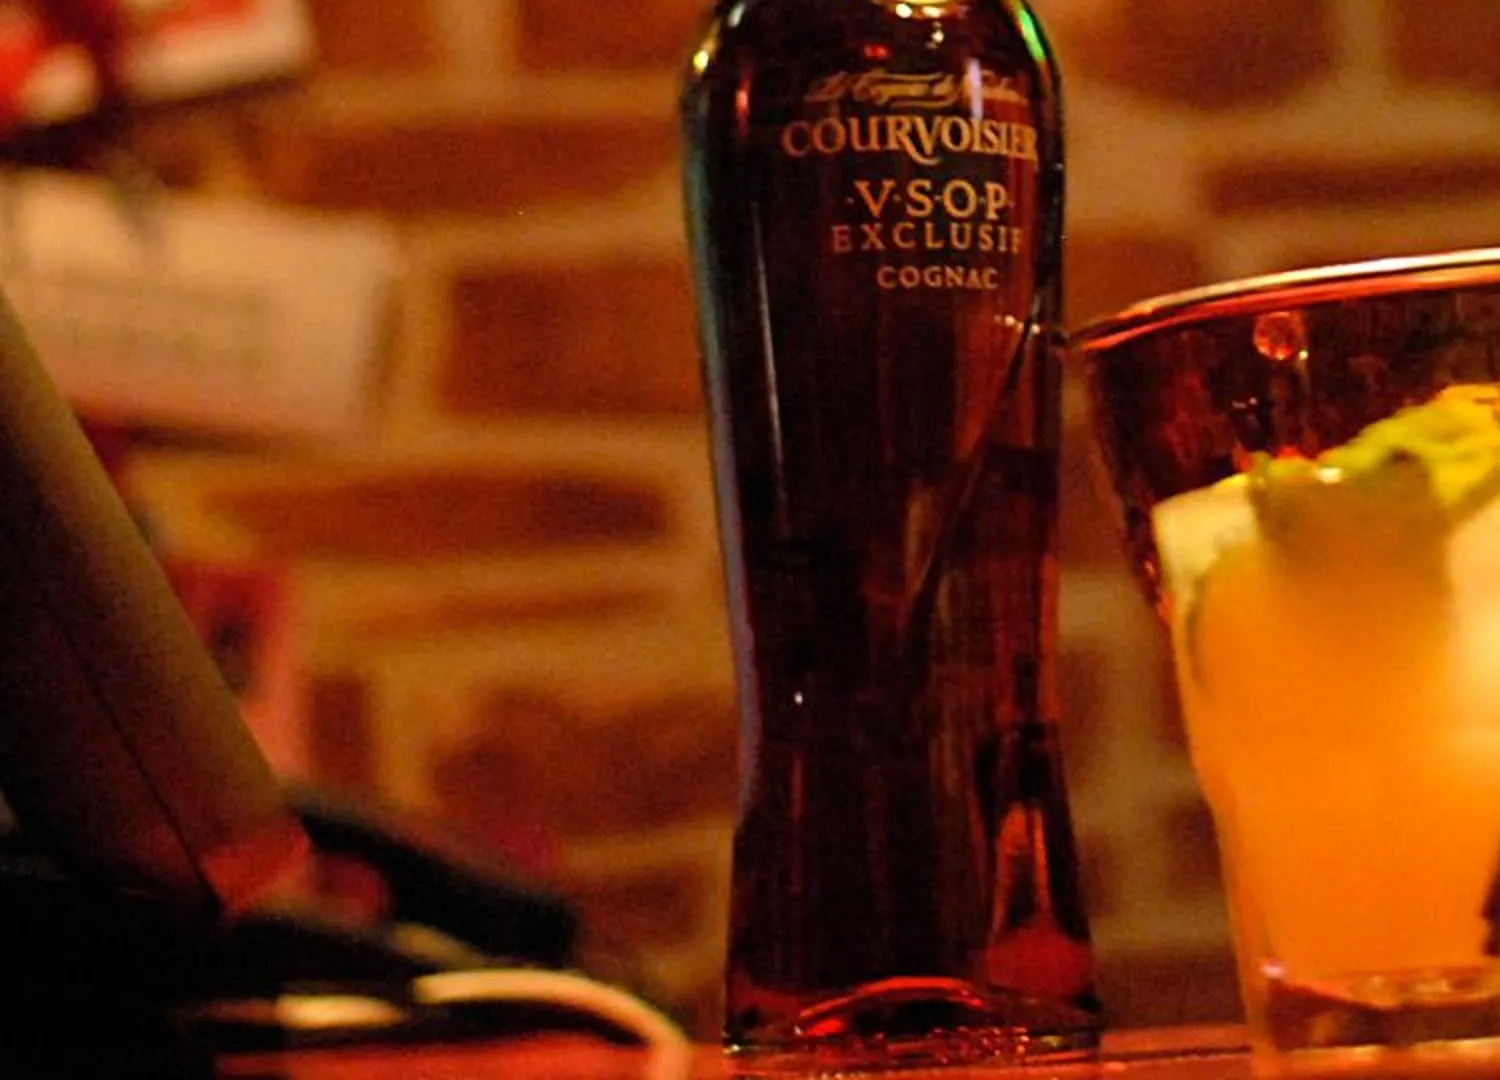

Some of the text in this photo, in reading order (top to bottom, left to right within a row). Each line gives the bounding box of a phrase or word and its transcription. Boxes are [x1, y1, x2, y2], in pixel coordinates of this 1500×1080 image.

[782, 115, 1037, 165] COURVOISIER
[832, 222, 1023, 255] EXCLUSIF
[876, 265, 998, 290] COGNAC
